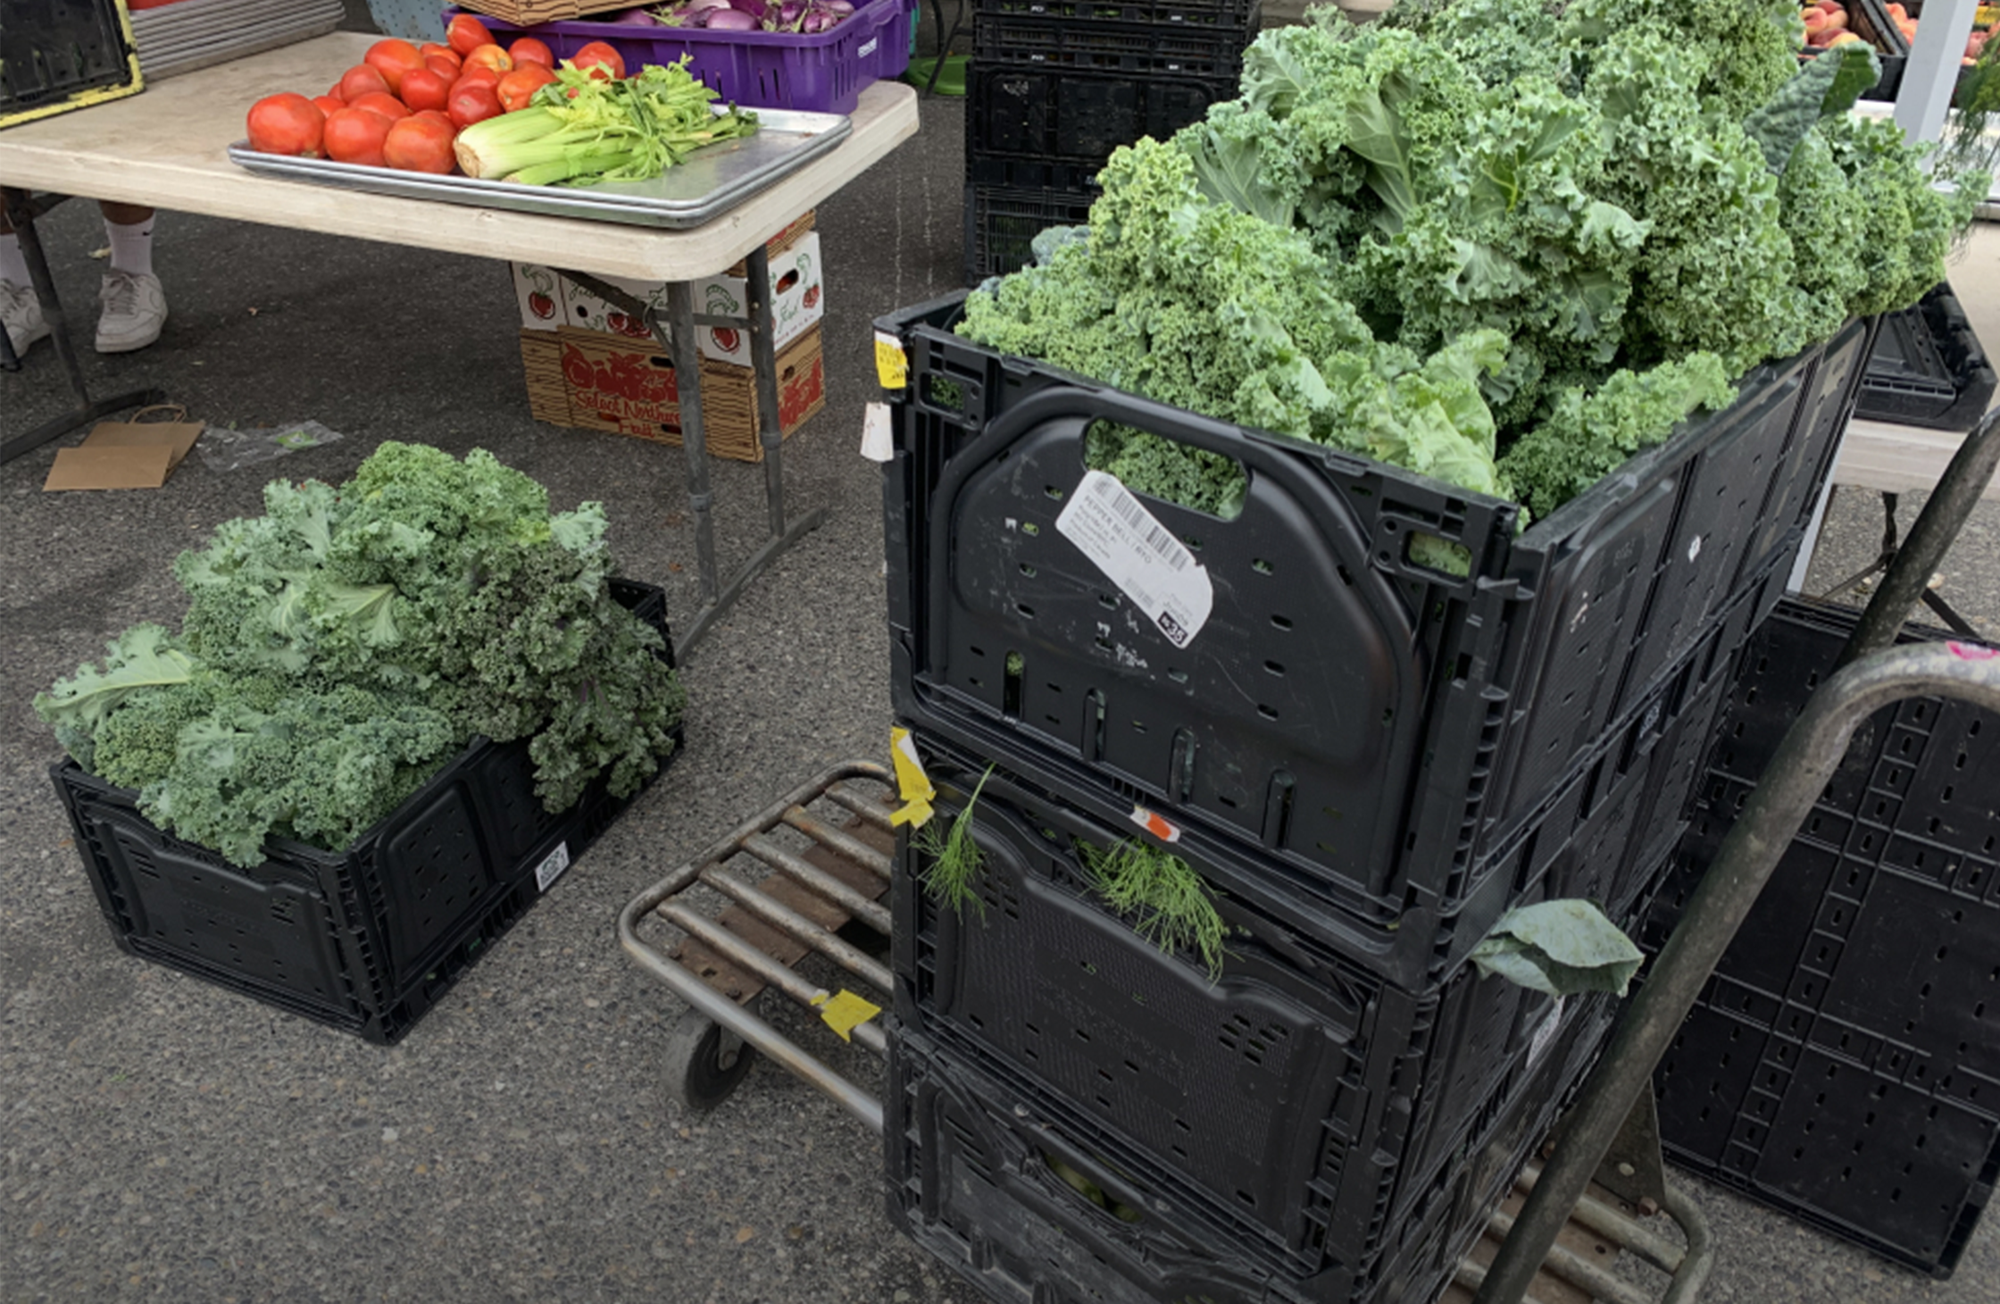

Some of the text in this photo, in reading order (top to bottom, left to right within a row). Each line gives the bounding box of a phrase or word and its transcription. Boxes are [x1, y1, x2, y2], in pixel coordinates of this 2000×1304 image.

[575, 390, 680, 423] Select Northwe
[617, 417, 655, 437] Fruit
[1083, 495, 1113, 525] PEPPER
[1112, 522, 1132, 545] BELL
